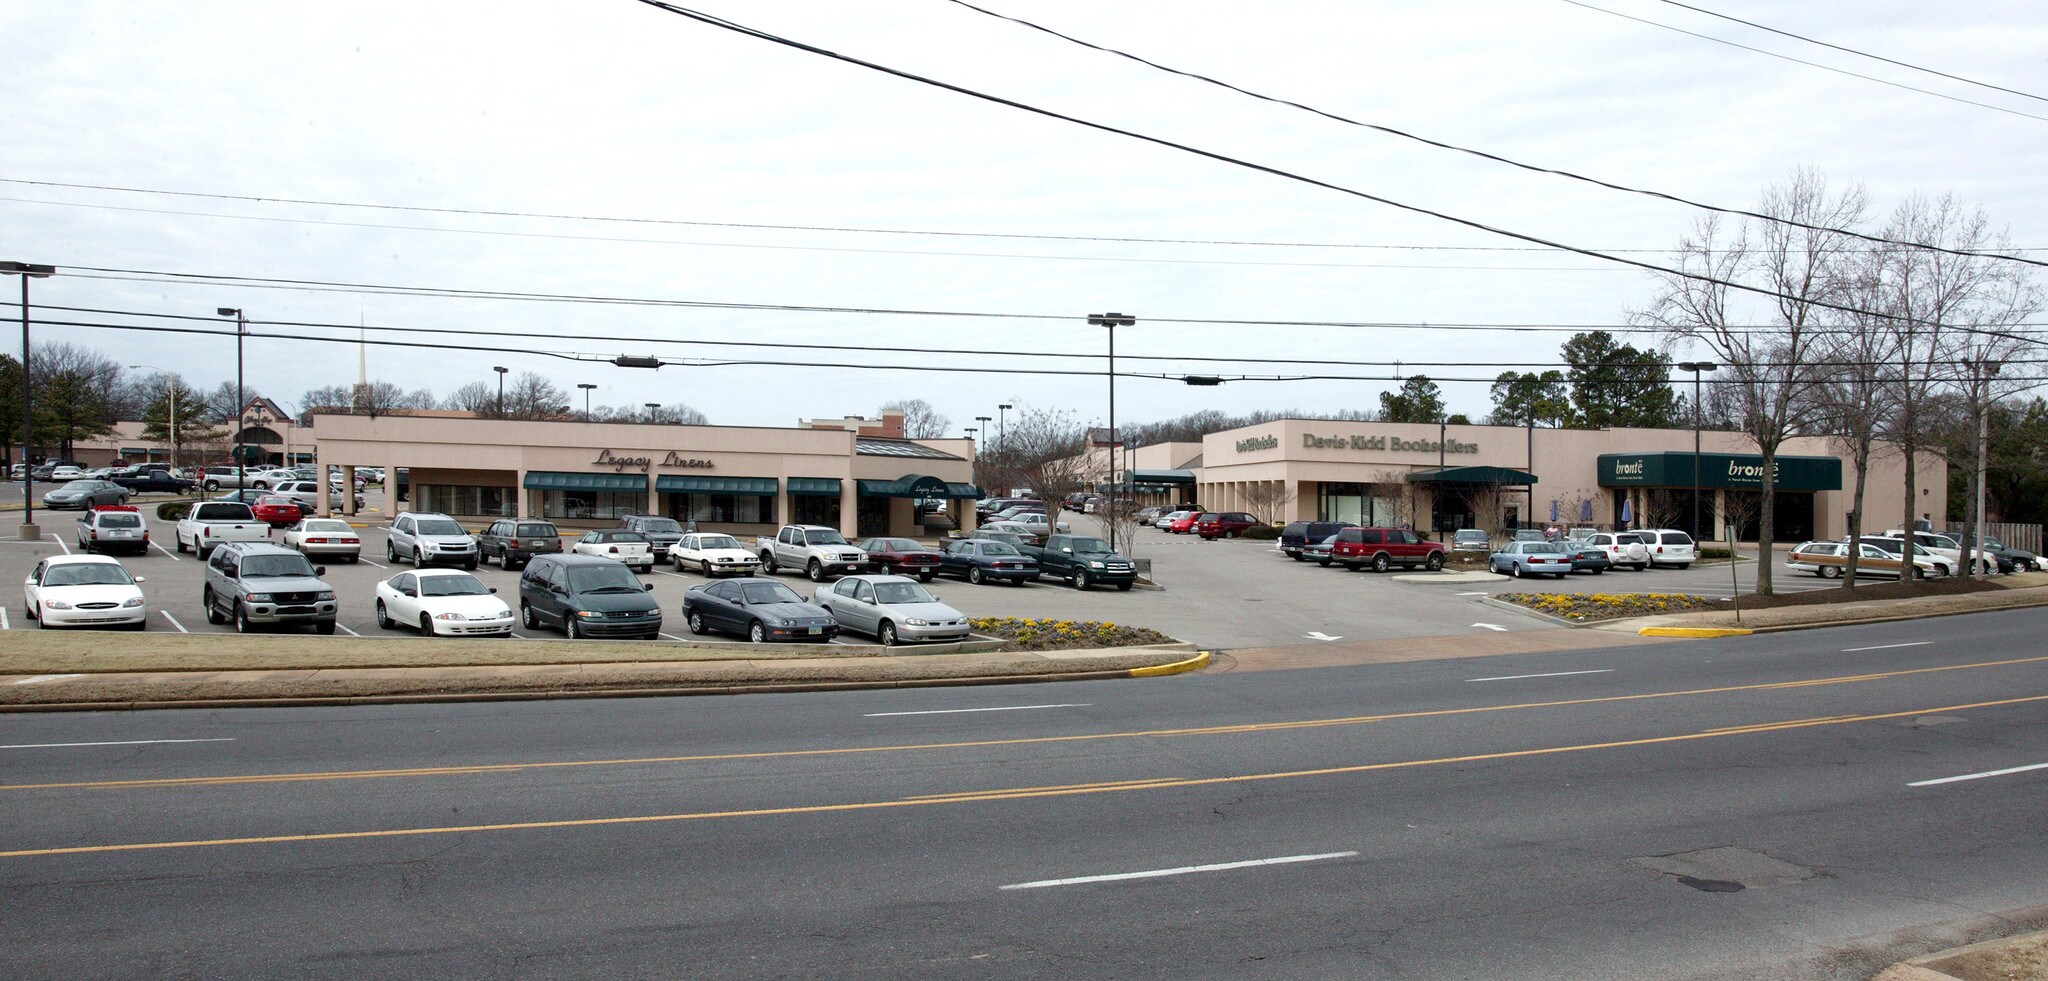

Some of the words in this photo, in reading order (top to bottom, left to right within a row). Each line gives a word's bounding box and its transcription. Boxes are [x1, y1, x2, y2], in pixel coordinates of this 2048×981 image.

[1390, 436, 1478, 453] Booksellers
[591, 449, 651, 472] Legacy
[657, 450, 715, 468] Linens
[1615, 459, 1643, 475] brontë
[1728, 460, 1779, 477] bronë
